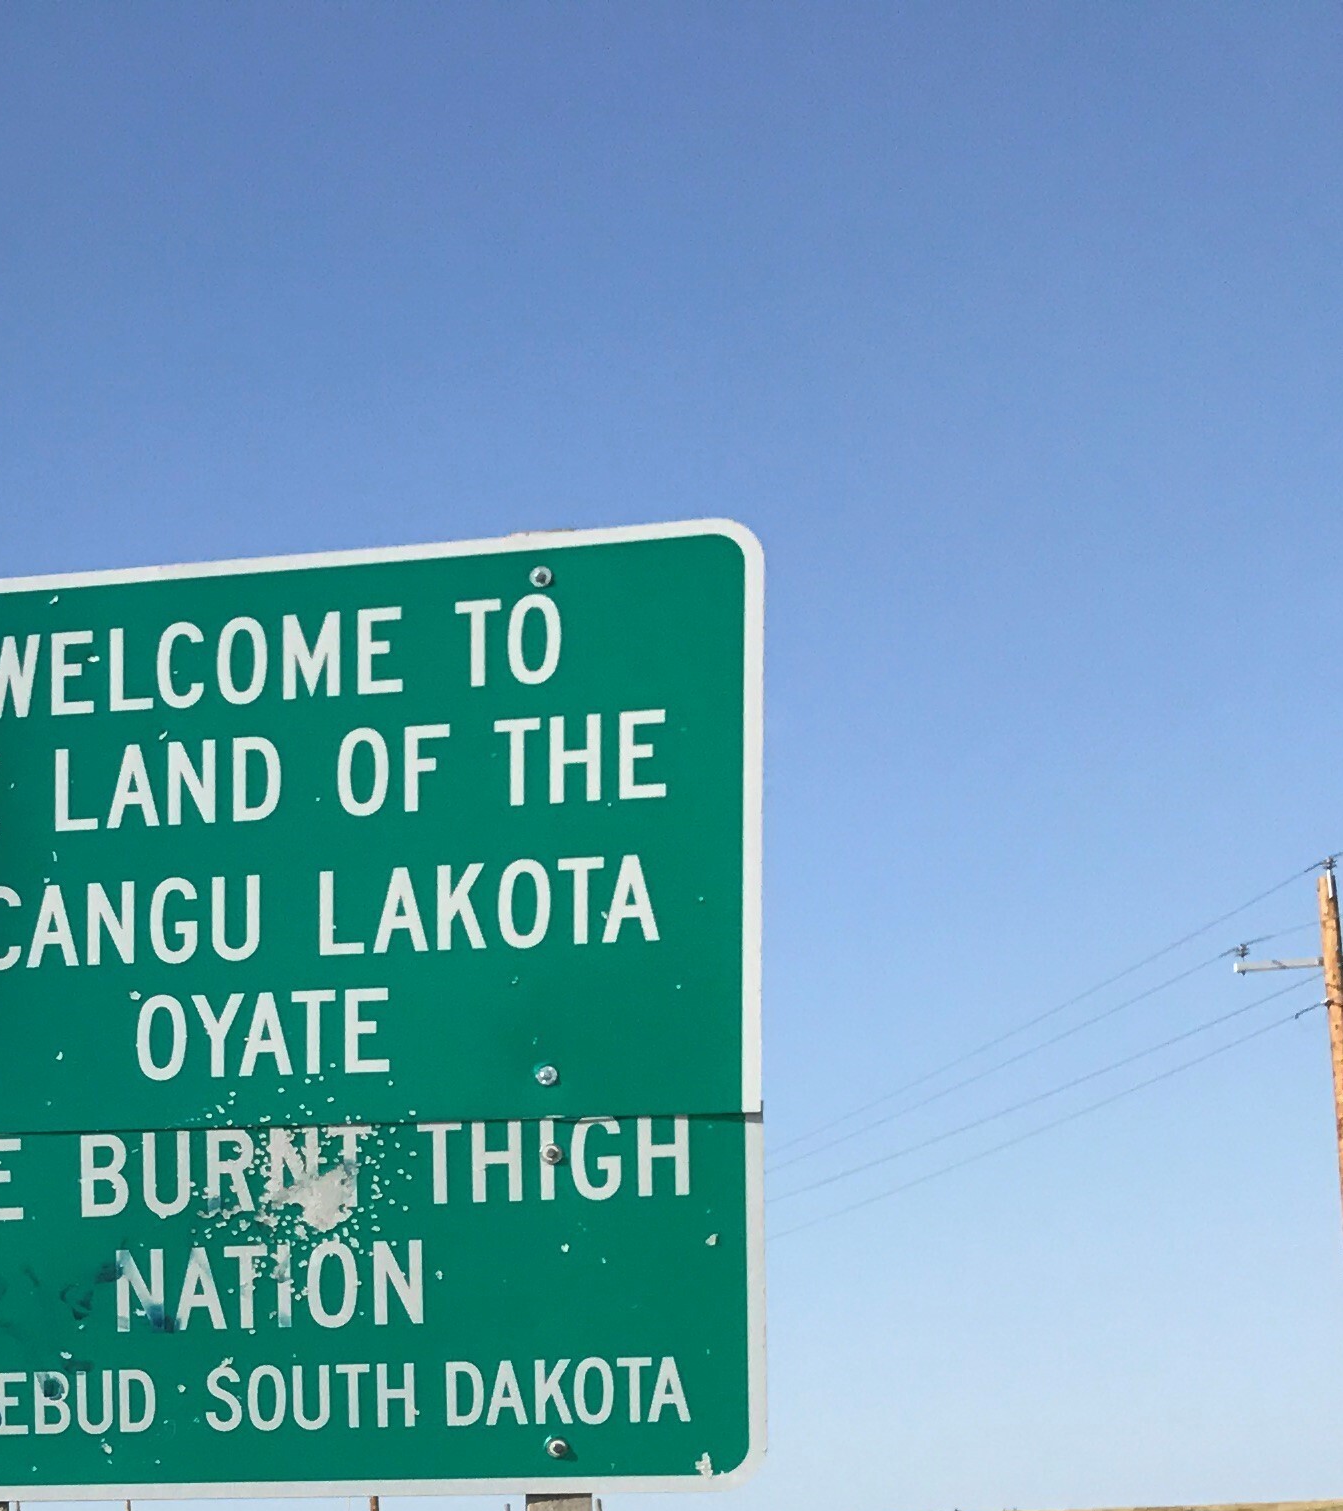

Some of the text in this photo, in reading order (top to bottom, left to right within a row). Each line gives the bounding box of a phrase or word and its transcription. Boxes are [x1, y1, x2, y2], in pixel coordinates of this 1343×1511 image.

[454, 593, 562, 688] TO
[54, 737, 282, 832] LAND
[337, 723, 451, 817] OF
[494, 709, 667, 806] THE
[319, 854, 660, 956] LAKOTA
[136, 988, 390, 1081] OYATE
[80, 1126, 372, 1219] BURNT
[416, 1118, 691, 1205] THIGH
[116, 1239, 424, 1332] NATION
[206, 1362, 420, 1432] SOUTH
[445, 1357, 691, 1427] DAKOTA
